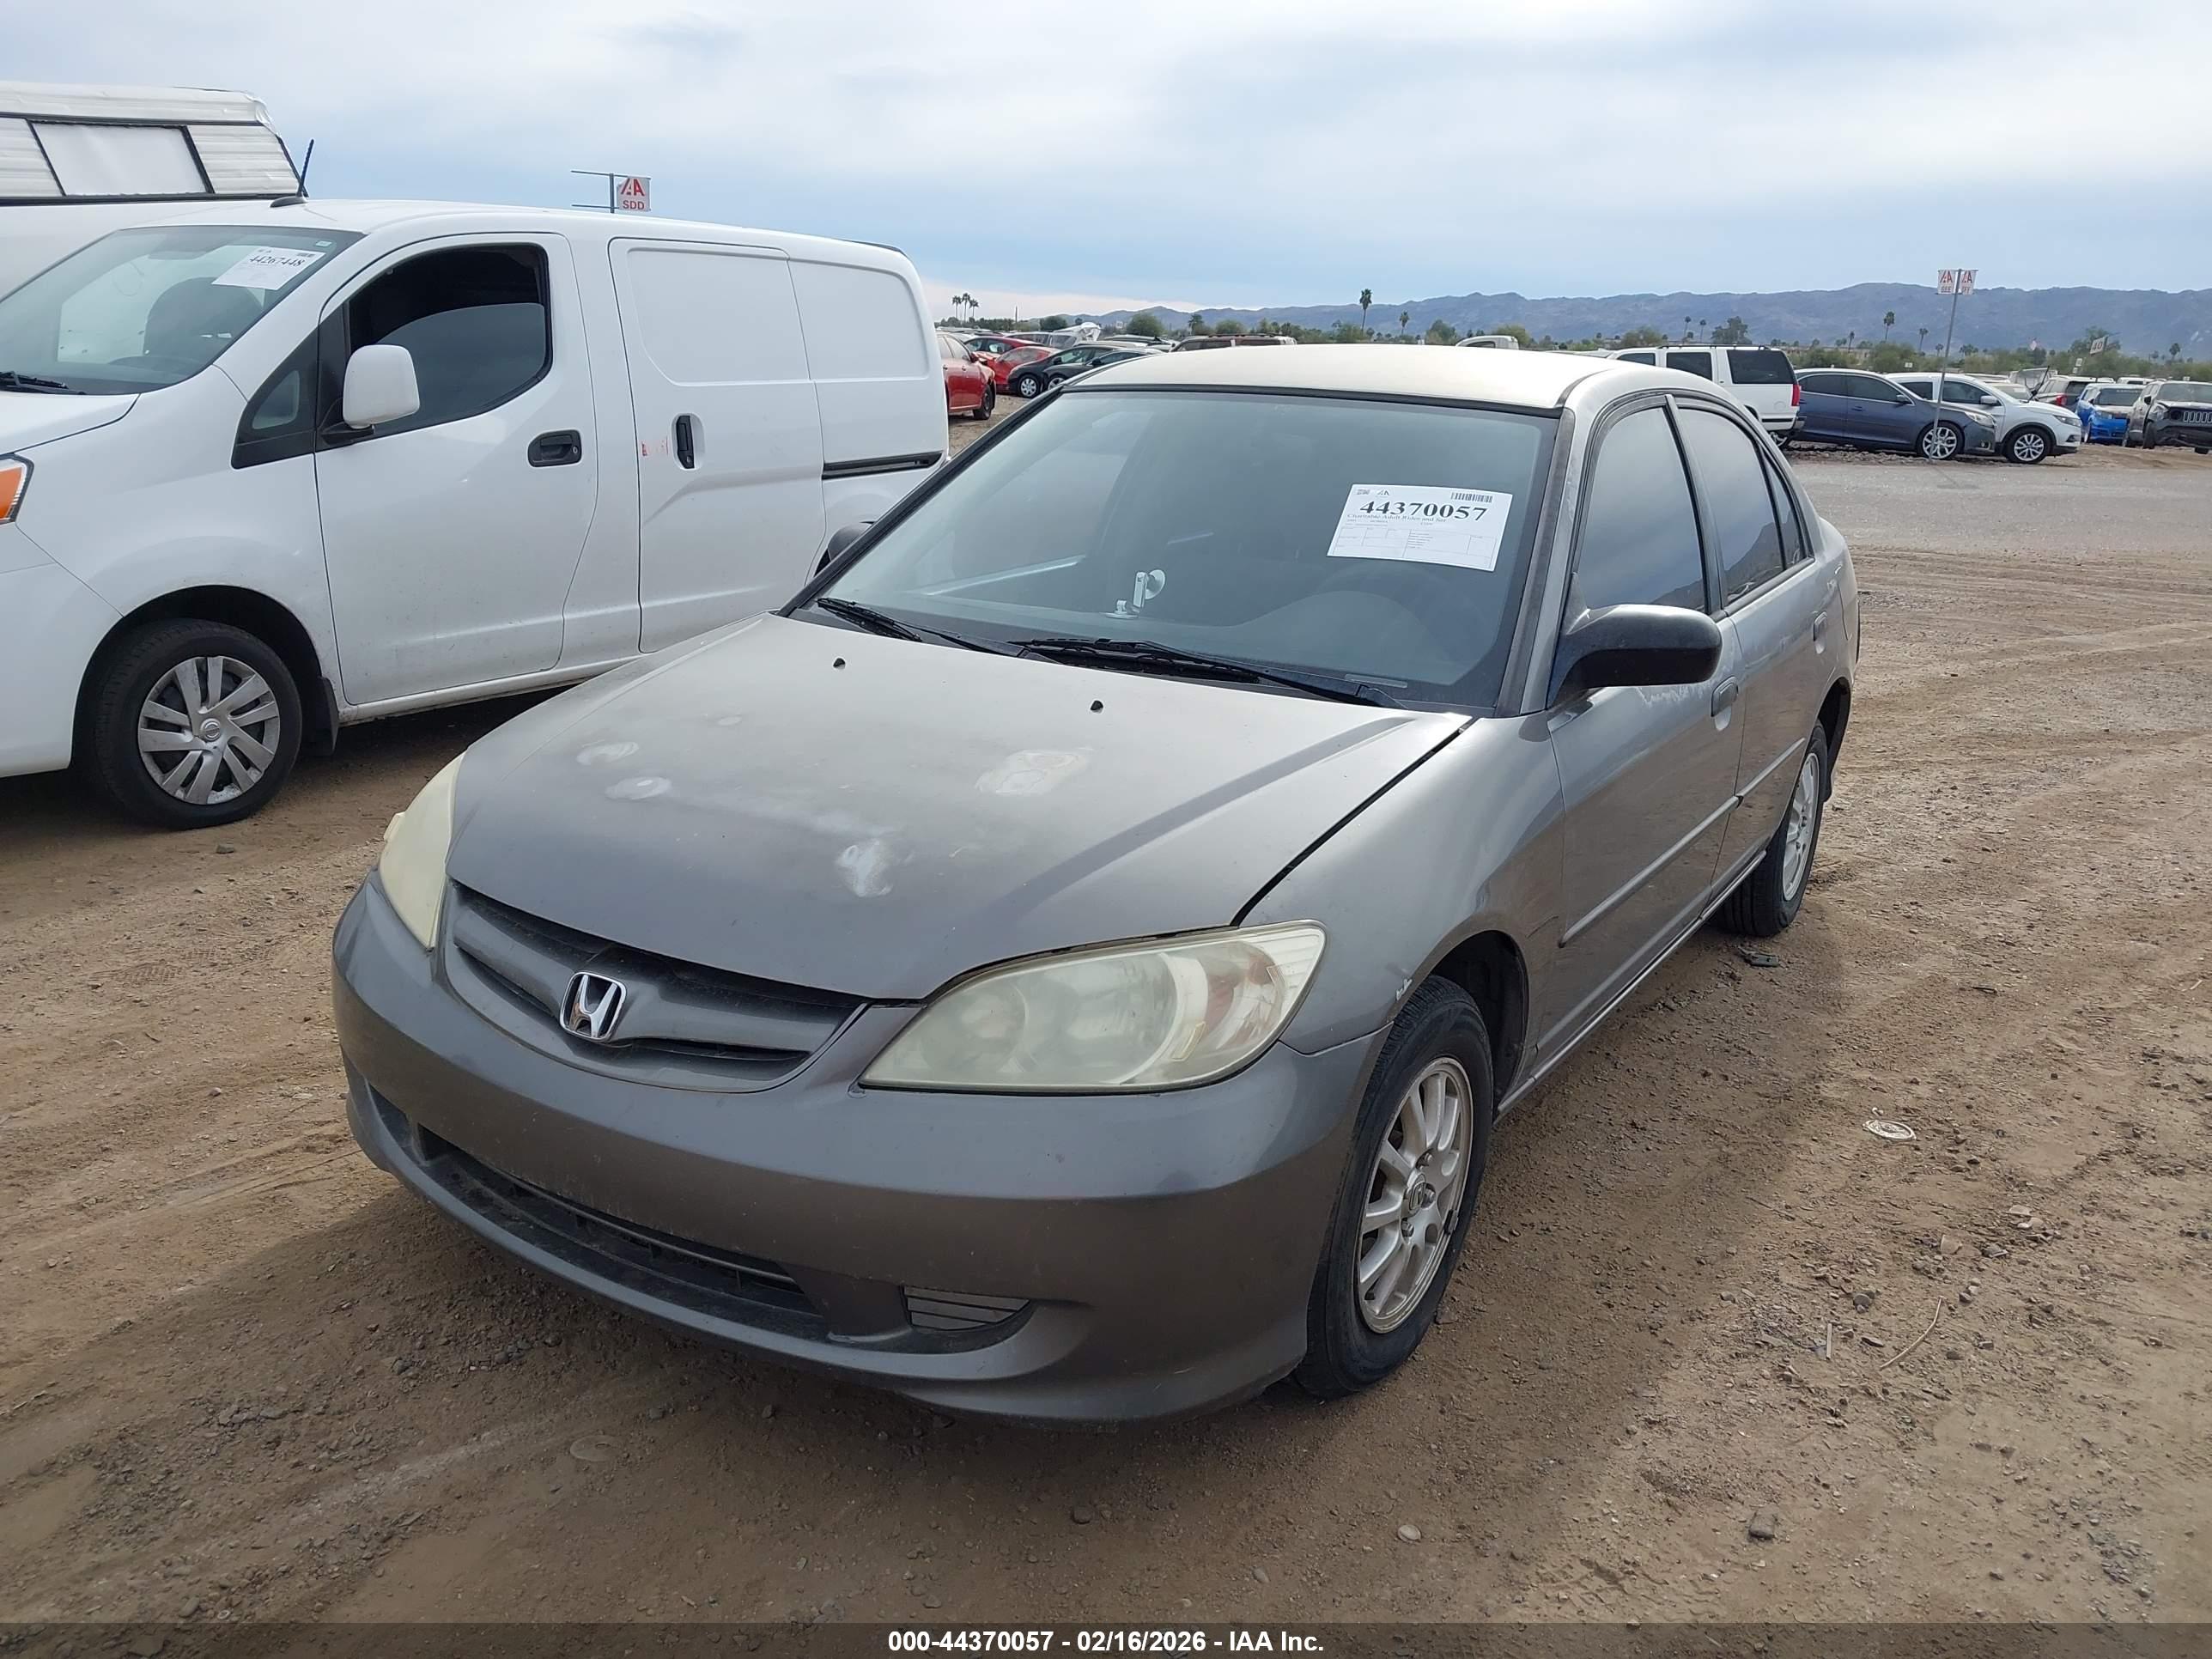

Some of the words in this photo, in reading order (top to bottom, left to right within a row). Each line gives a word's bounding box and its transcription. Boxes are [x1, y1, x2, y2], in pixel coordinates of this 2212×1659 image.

[623, 199, 645, 210] SDD
[249, 254, 306, 267] 44267448
[1358, 501, 1489, 521] 44370057
